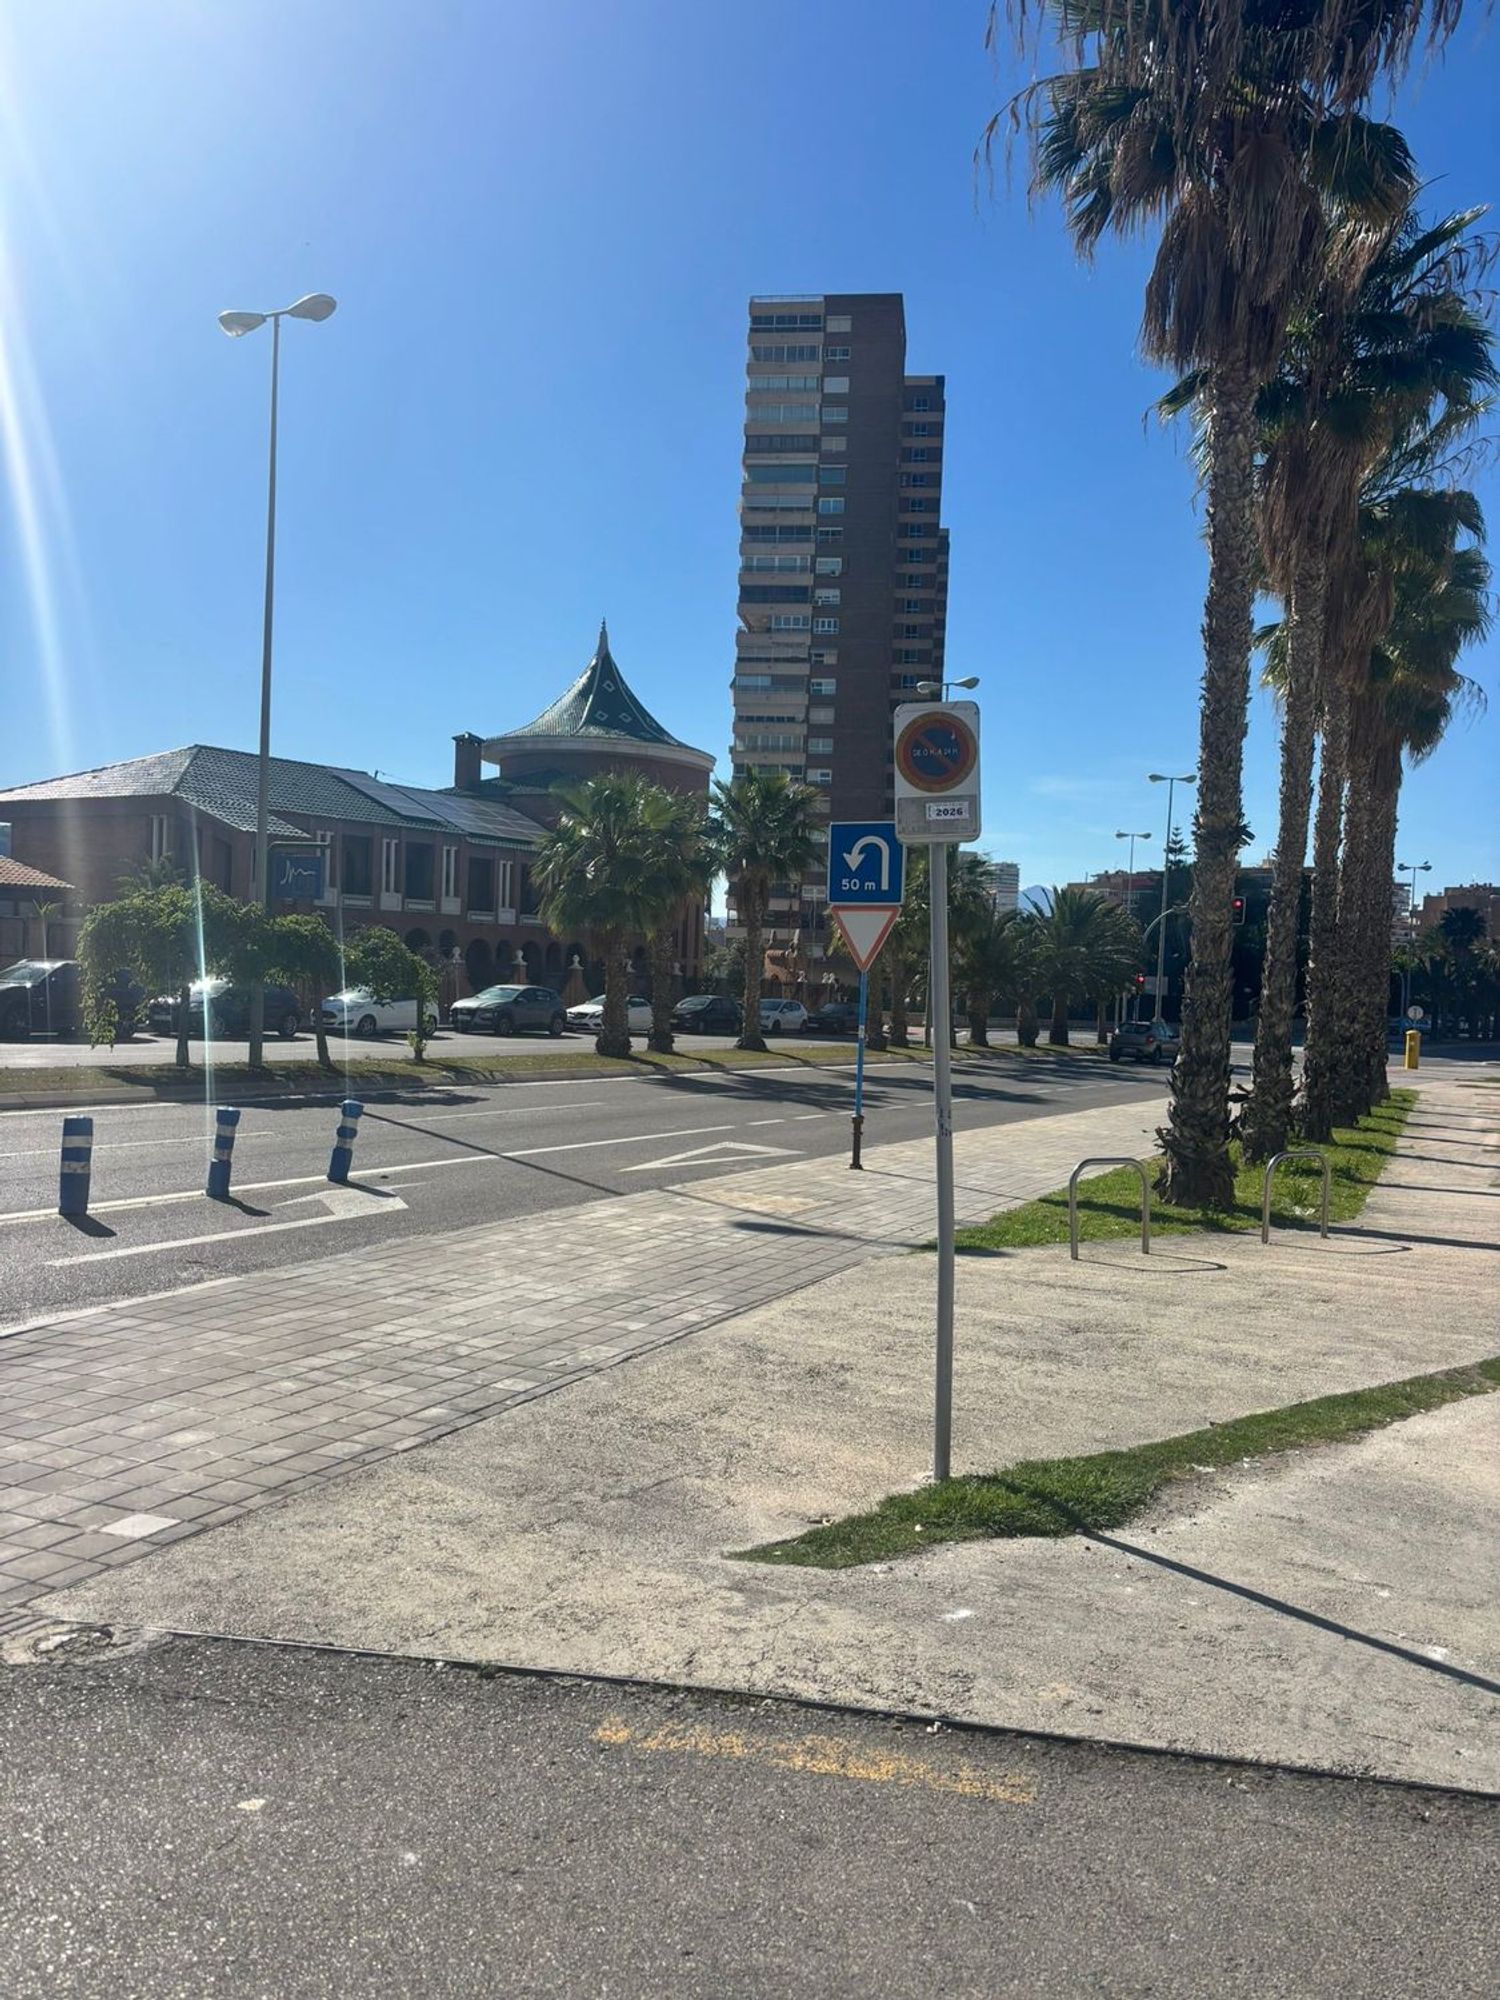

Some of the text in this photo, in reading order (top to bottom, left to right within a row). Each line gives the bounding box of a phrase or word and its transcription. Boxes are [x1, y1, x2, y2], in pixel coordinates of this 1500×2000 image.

[936, 807, 963, 817] 2026
[841, 878, 876, 891] 50 m
